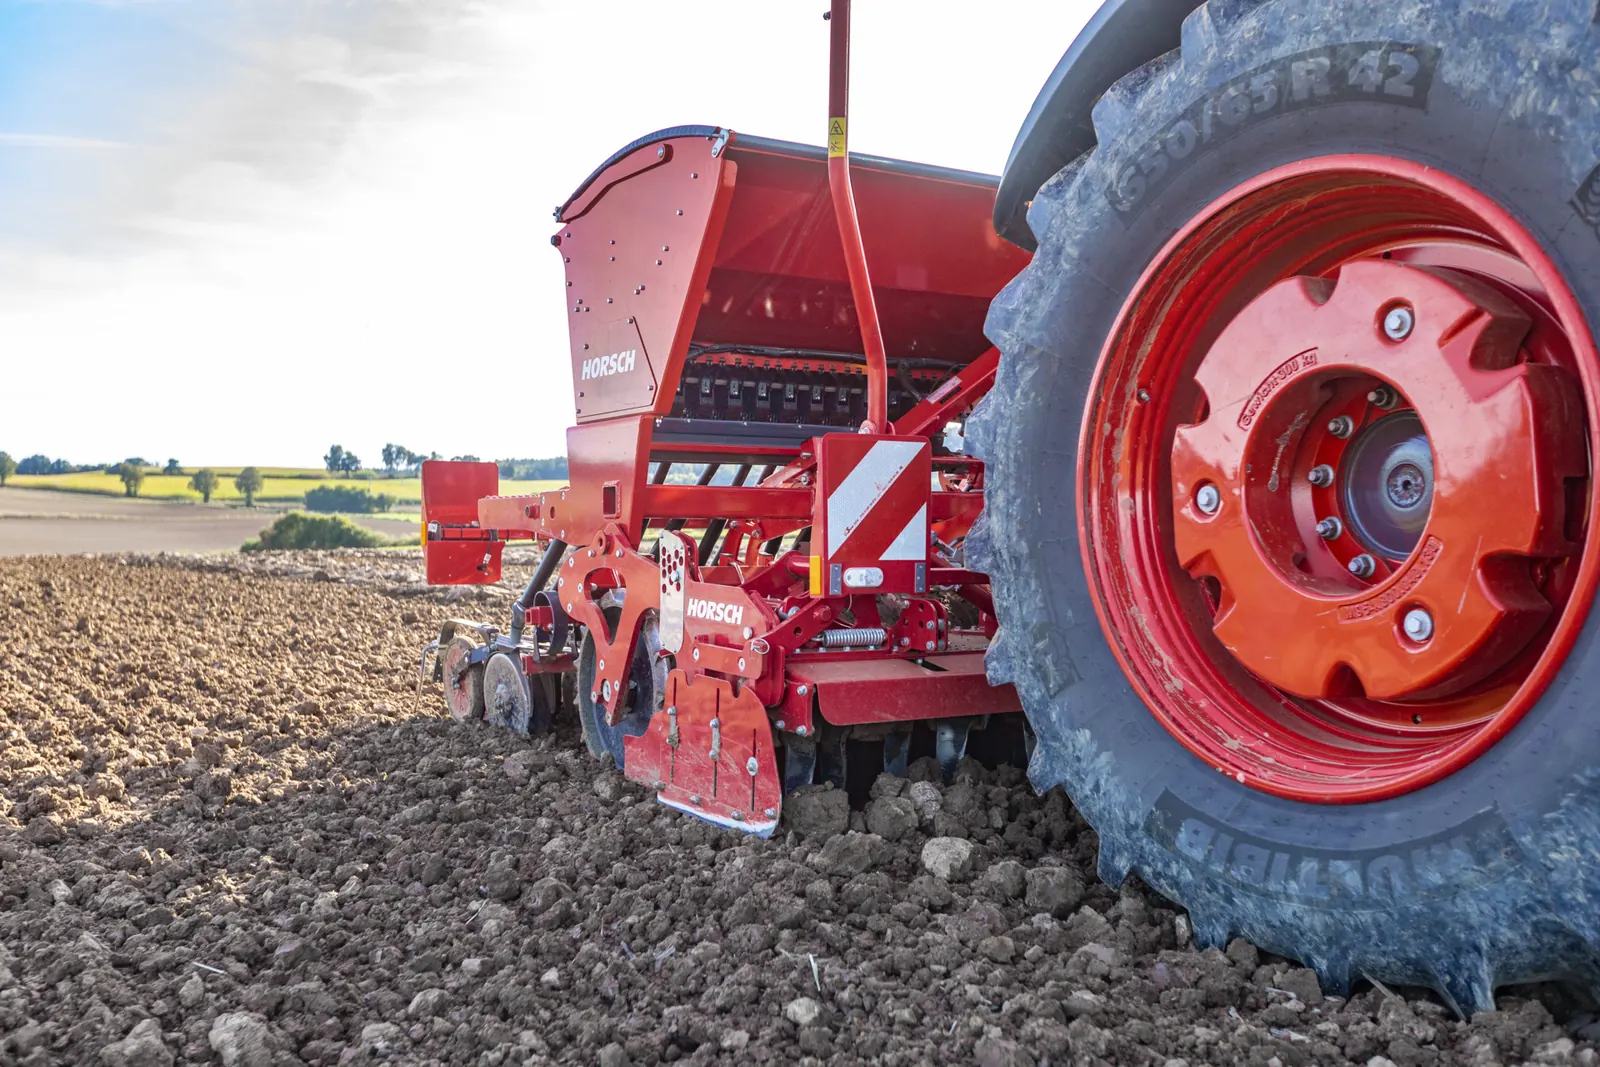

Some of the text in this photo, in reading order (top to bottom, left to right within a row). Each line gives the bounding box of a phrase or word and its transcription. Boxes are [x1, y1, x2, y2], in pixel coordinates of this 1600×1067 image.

[1292, 56, 1331, 99] R
[1348, 50, 1420, 98] 42
[581, 349, 636, 380] HORSCH
[687, 598, 744, 625] HORSCH
